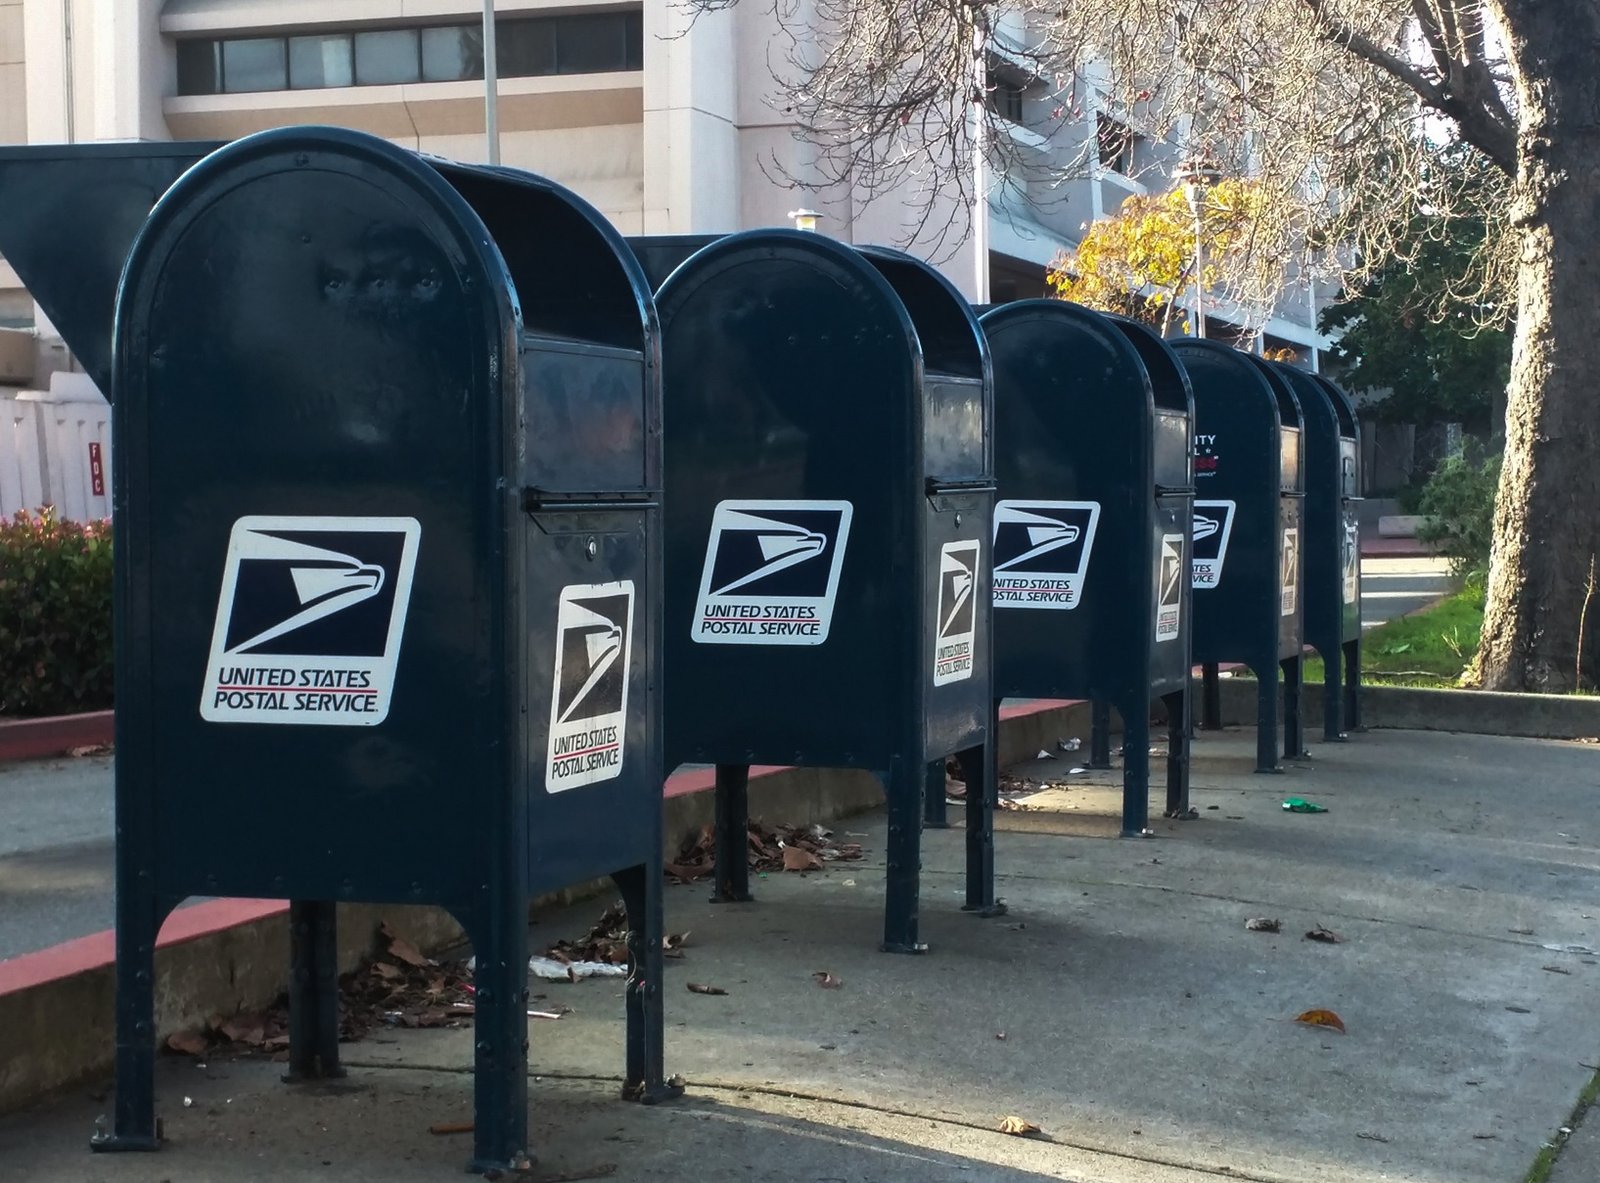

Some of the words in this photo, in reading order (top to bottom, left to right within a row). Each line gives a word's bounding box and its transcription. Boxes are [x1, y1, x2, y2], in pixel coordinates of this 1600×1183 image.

[1195, 434, 1216, 445] ITY
[1193, 564, 1212, 573] TES
[993, 578, 1028, 589] NITED
[1029, 579, 1071, 590] STATES
[1193, 574, 1214, 583] VICE
[993, 591, 1024, 601] OSTAL
[704, 604, 761, 618] UNITED
[763, 605, 816, 619] STATES
[701, 621, 756, 635] POSTAL
[218, 667, 296, 686] UNITED
[299, 669, 371, 688] STATES
[214, 691, 289, 710] POSTAL
[554, 732, 588, 755] UNITED
[588, 725, 617, 748] STATES
[551, 758, 585, 780] POSTAL
[586, 748, 619, 771] SERVICE
